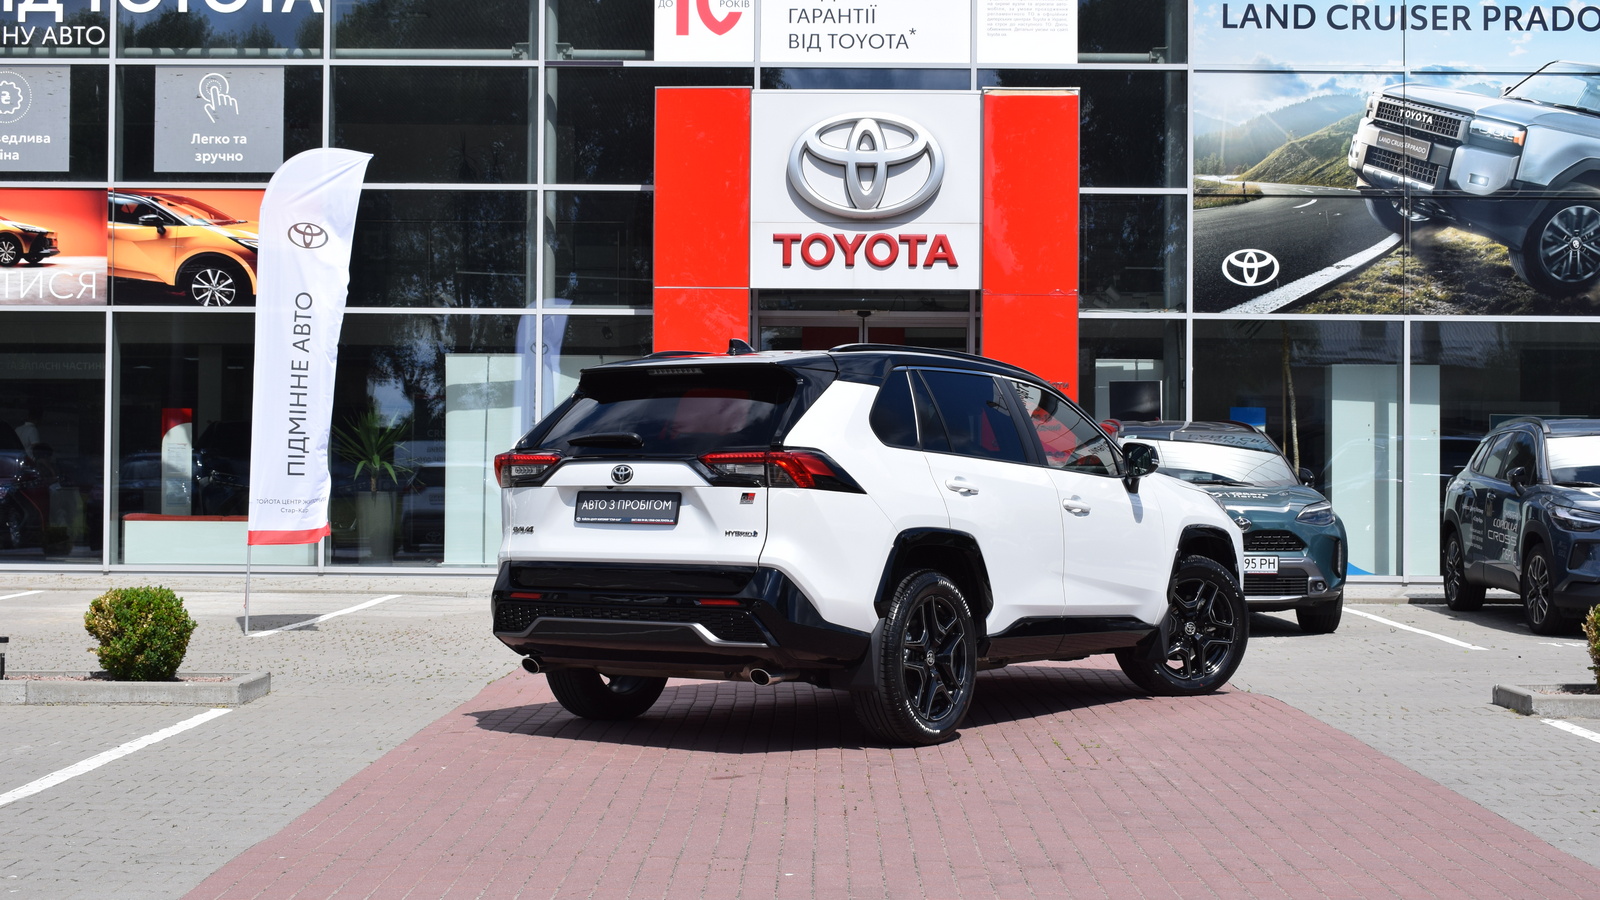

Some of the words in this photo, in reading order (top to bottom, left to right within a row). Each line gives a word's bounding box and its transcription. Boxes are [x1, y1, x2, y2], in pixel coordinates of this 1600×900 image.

[788, 4, 876, 24] ГАРАНТІЇ
[1221, 3, 1317, 30] LAND
[1326, 5, 1473, 31] CRUISER
[1482, 6, 1600, 33] PRADO
[41, 25, 106, 45] АВТО
[788, 33, 822, 52] ВІД
[1400, 108, 1433, 125] TOYOTA
[0, 134, 51, 145] едлива
[190, 133, 230, 144] Легко
[233, 135, 248, 144] та
[194, 152, 244, 163] зручно
[773, 232, 959, 269] TOYOTA
[0, 270, 96, 299] ТИСЯ
[292, 292, 313, 353] АВТО
[287, 360, 310, 476] ПІДМІННЕ
[282, 498, 302, 506] ЦЕНТР
[581, 499, 607, 510] АВТО
[608, 499, 615, 510] З
[617, 499, 672, 510] ПРОБІГОМ
[1493, 517, 1518, 532] COROLLA
[1487, 529, 1518, 547] CROSS
[1244, 558, 1257, 569] 95
[1259, 558, 1276, 569] PH
